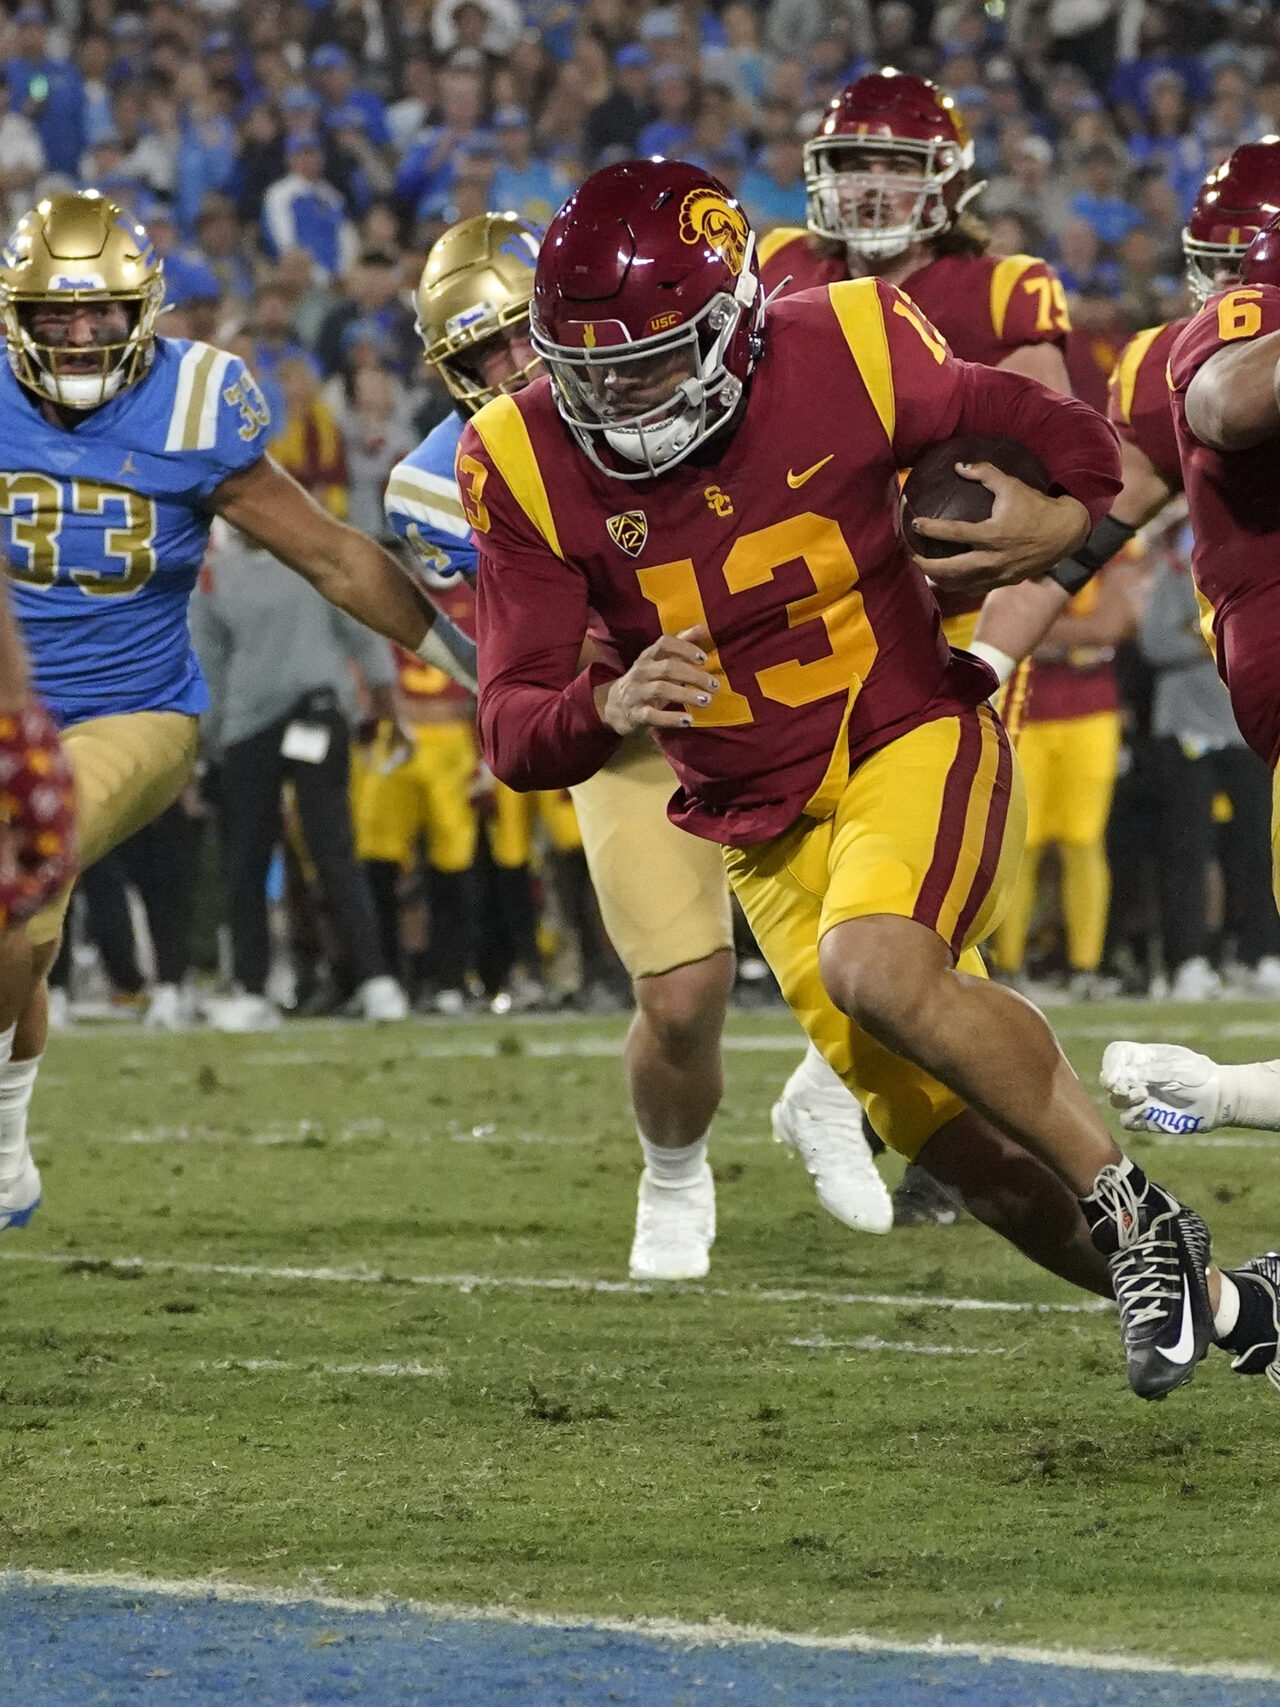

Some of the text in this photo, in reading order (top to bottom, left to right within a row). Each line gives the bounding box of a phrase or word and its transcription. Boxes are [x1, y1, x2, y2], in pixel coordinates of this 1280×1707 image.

[651, 314, 677, 331] USC
[1218, 290, 1263, 341] 6
[0, 472, 157, 598] 33
[608, 512, 646, 541] PAC
[621, 530, 642, 549] 12
[636, 511, 879, 727] 13
